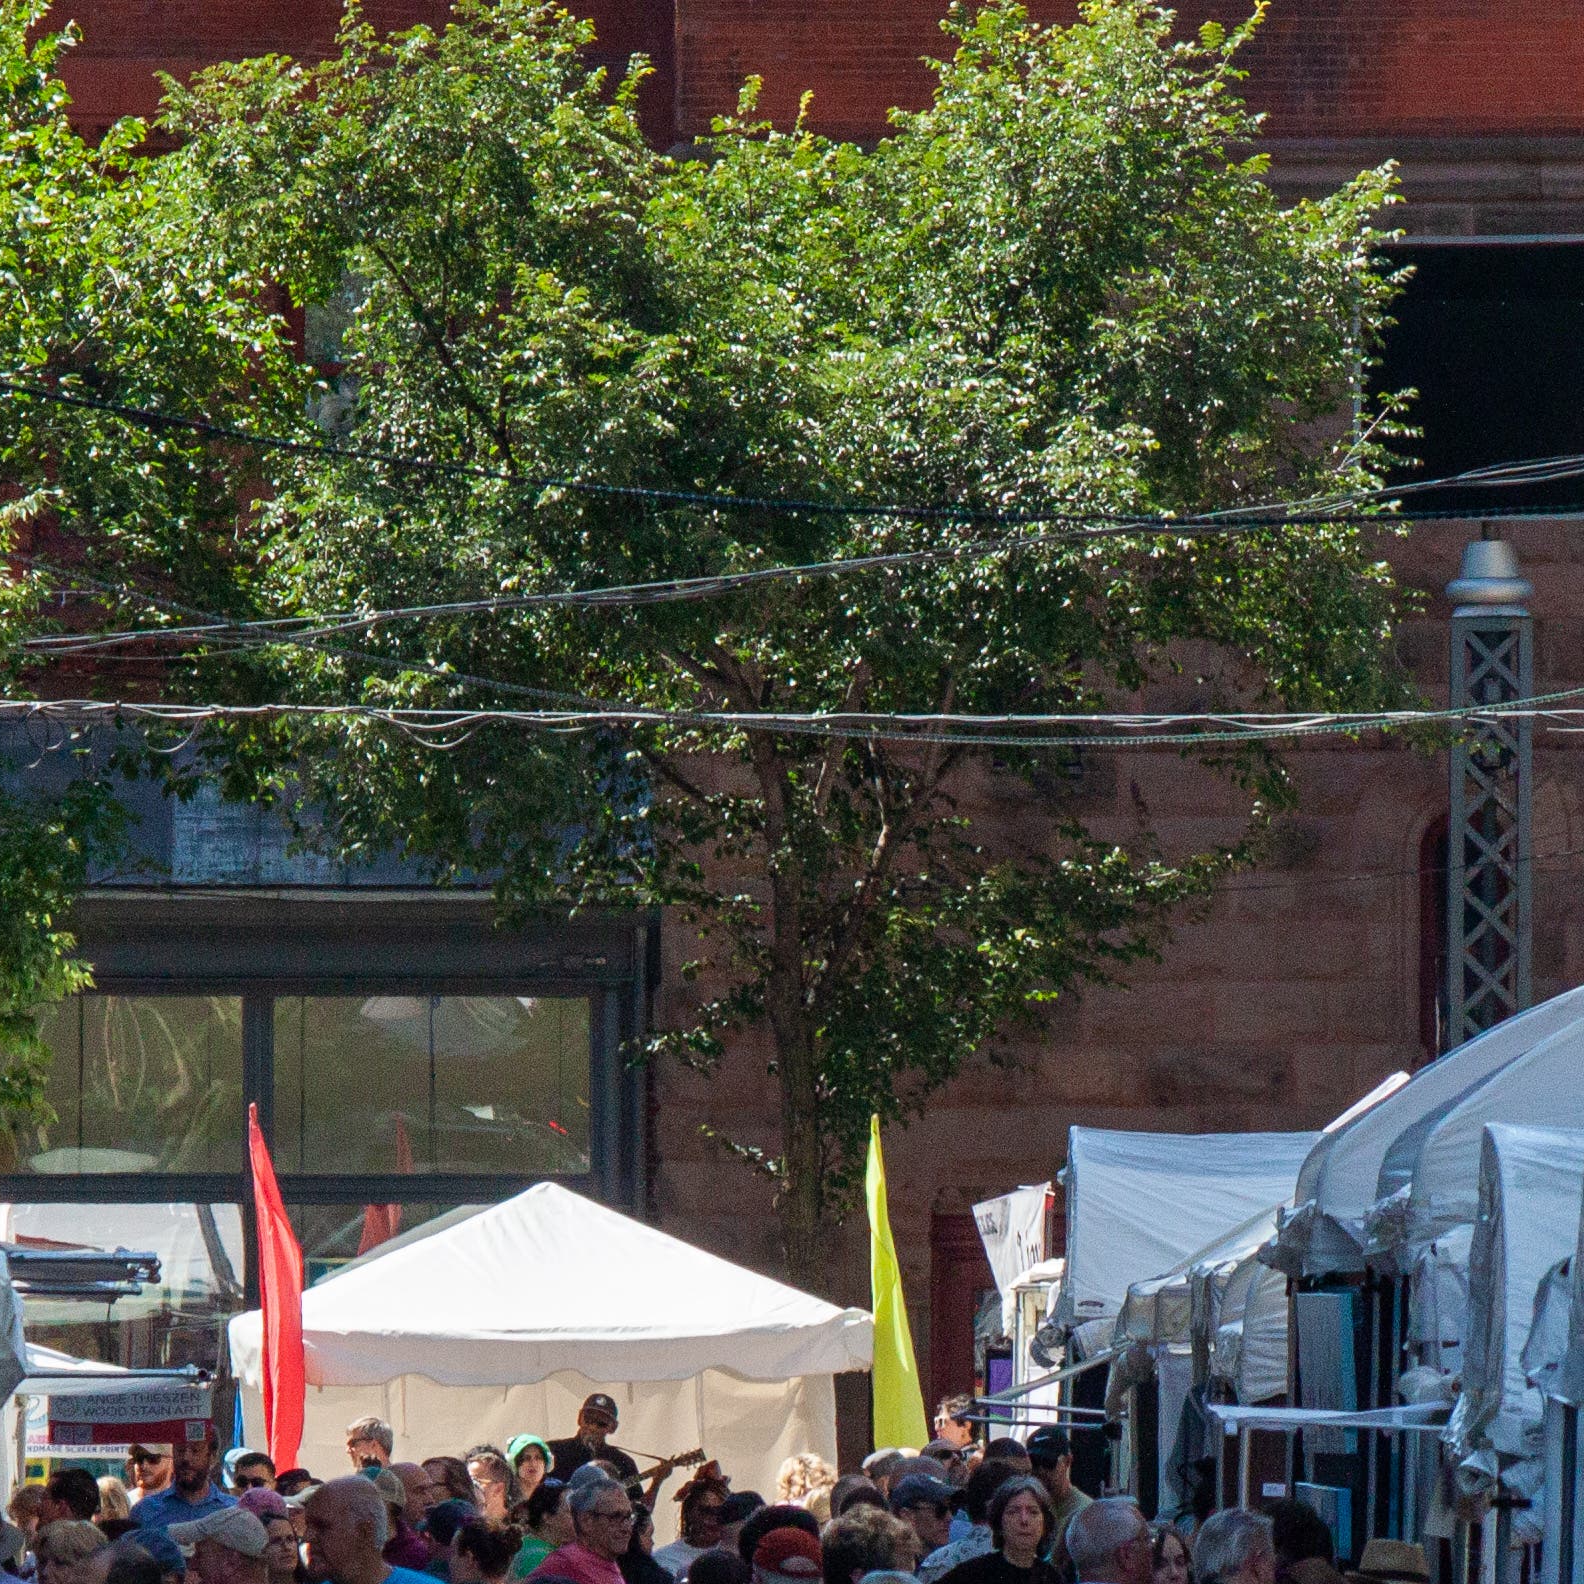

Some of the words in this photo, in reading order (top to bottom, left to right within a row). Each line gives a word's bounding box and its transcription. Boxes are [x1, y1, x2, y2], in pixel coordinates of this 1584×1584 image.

[85, 1393, 127, 1405] ANGIE
[83, 1405, 128, 1417] WOOD
[130, 1404, 173, 1417] STAIN
[174, 1403, 202, 1415] ART
